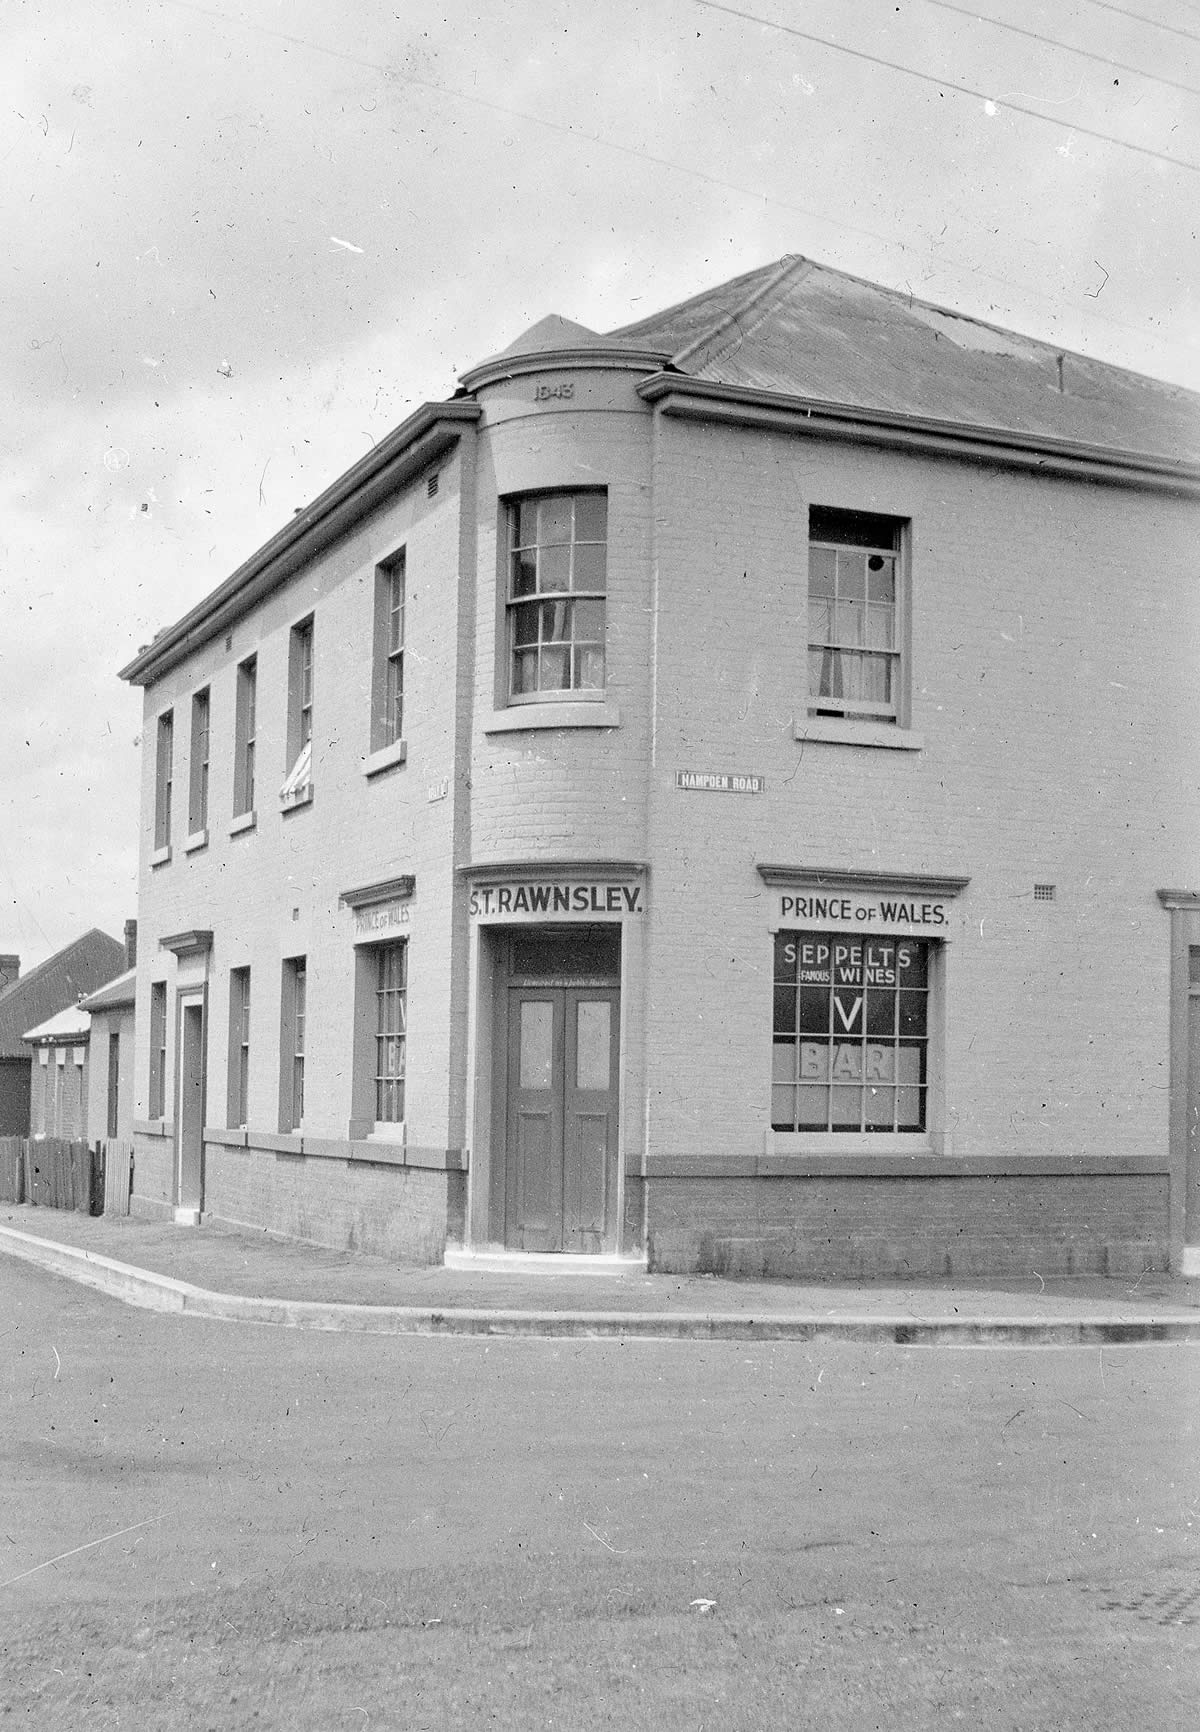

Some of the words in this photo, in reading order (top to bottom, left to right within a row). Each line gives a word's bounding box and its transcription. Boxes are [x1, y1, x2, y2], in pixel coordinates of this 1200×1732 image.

[681, 774, 728, 788] HAMPDEN
[732, 777, 759, 790] ROAD
[781, 896, 852, 920] PRINCE
[855, 908, 877, 921] OF
[880, 902, 949, 925] WALES.
[784, 943, 911, 967] SEPPELTS
[800, 969, 831, 982] FAMOUS
[840, 966, 895, 984] WINES
[833, 996, 863, 1032] V
[800, 1042, 891, 1080] BAR
